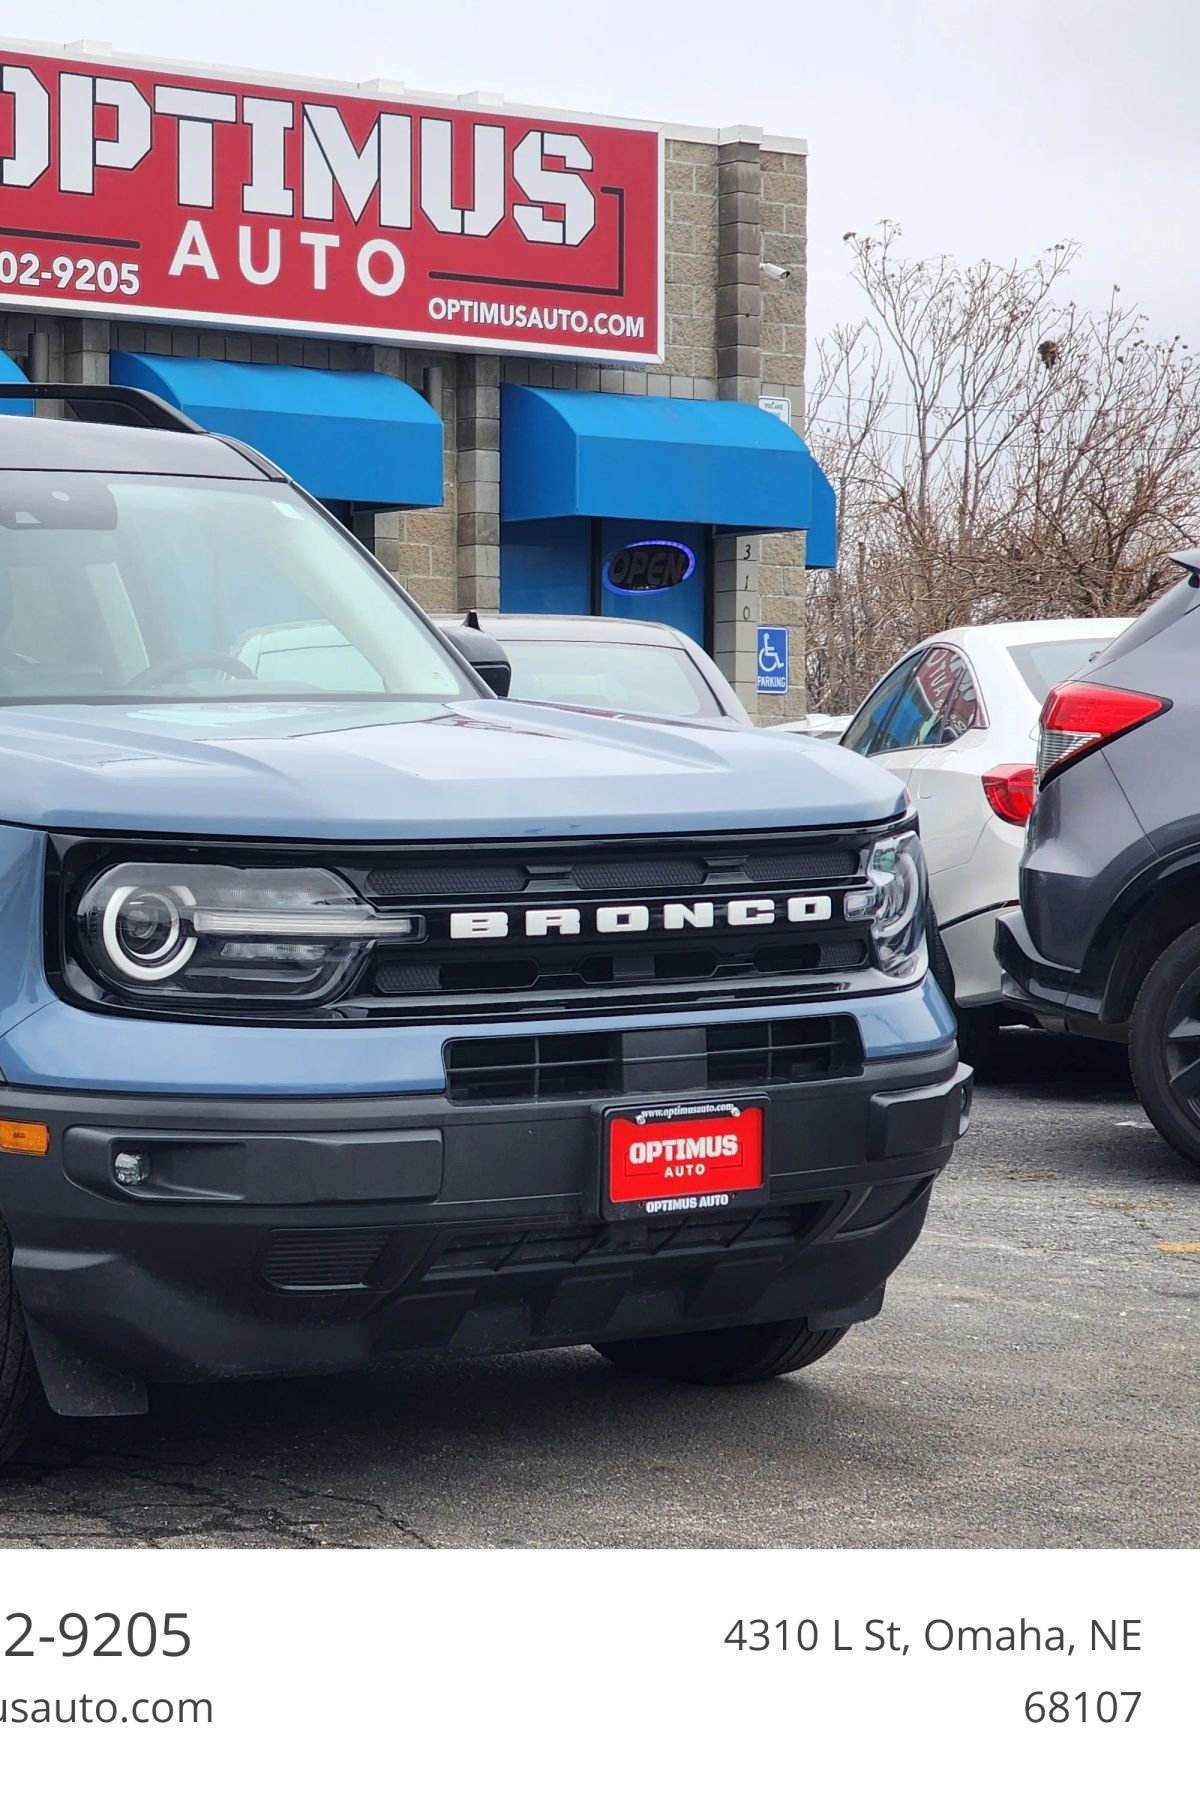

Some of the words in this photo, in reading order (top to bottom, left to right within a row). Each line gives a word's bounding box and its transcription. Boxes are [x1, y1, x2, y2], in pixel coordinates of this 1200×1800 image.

[168, 219, 406, 297] AUTO
[428, 296, 646, 338] OPTIMUSAUTO.COM
[610, 549, 686, 585] OPEN
[757, 675, 787, 688] PARKING
[451, 896, 832, 939] BRONCO
[641, 1103, 735, 1119] www.optimusauto.com
[630, 1135, 738, 1164] OPTIMUS
[665, 1164, 705, 1178] AUTO
[646, 1197, 697, 1213] OPTIMUS
[699, 1194, 729, 1207] AUTO
